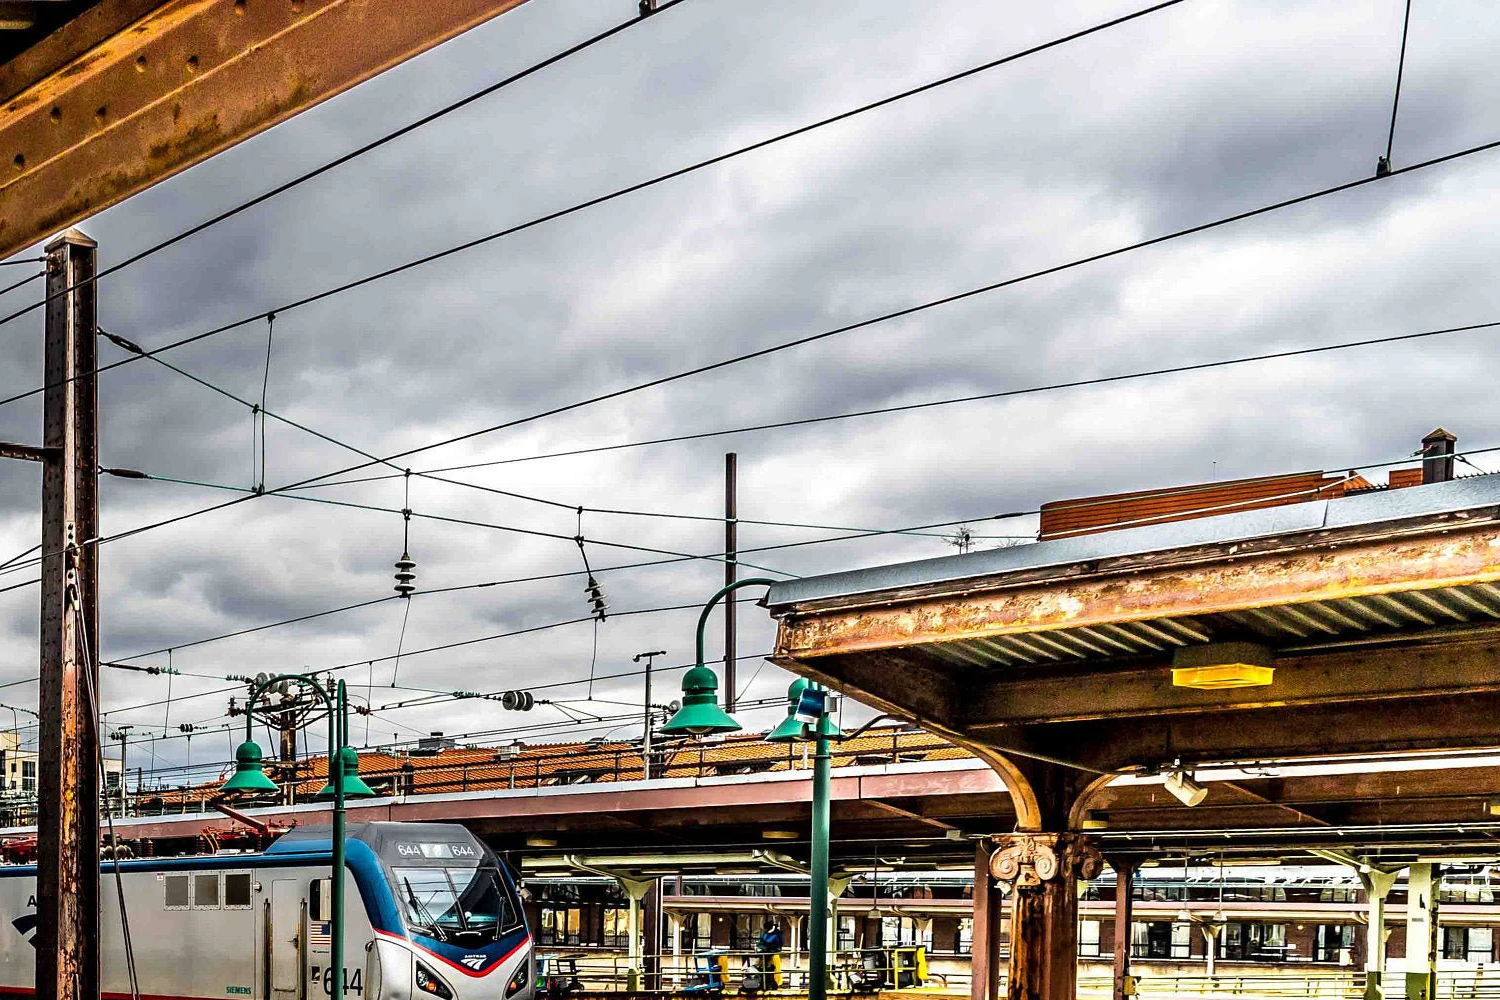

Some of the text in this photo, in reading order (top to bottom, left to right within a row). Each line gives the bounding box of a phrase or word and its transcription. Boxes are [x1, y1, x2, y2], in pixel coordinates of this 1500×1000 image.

[397, 844, 421, 856] 644
[451, 845, 474, 856] 644
[226, 986, 252, 995] SIEMENS
